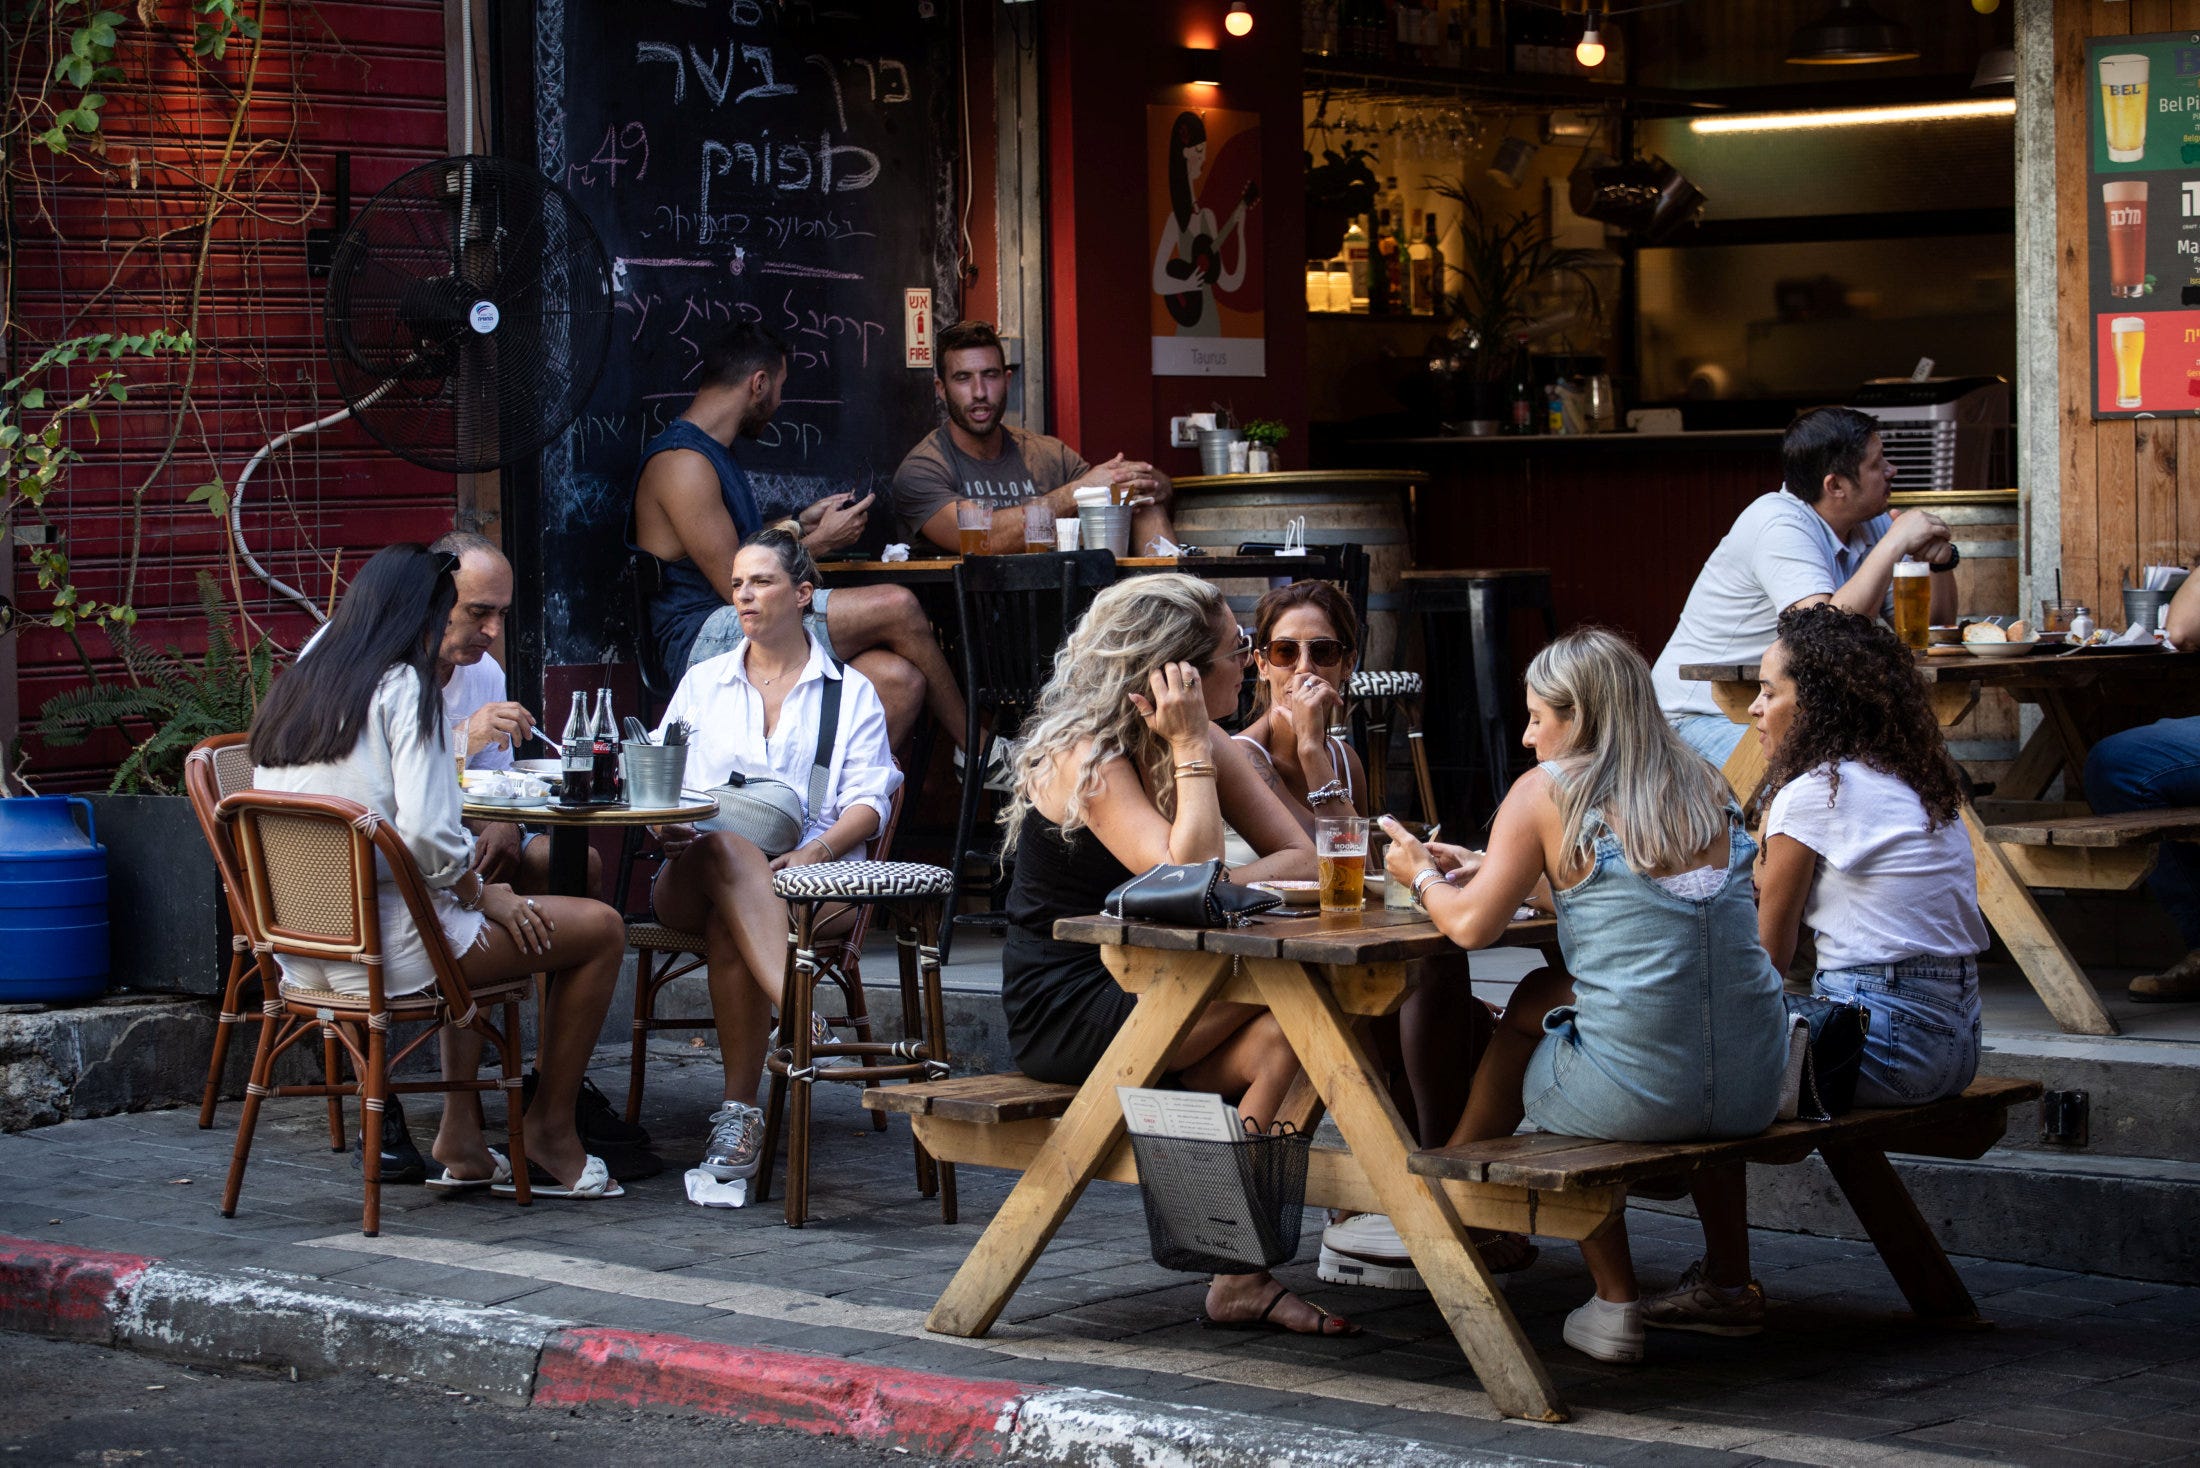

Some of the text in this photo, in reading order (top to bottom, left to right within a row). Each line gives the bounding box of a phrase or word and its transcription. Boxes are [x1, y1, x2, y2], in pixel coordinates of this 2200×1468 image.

[636, 40, 798, 106] בשר
[2109, 84, 2141, 96] BEL
[2159, 96, 2183, 112] Bel
[2110, 207, 2141, 226] מלכה
[909, 295, 928, 309] אש
[909, 347, 930, 361] FIRE
[1191, 348, 1227, 365] Taurus
